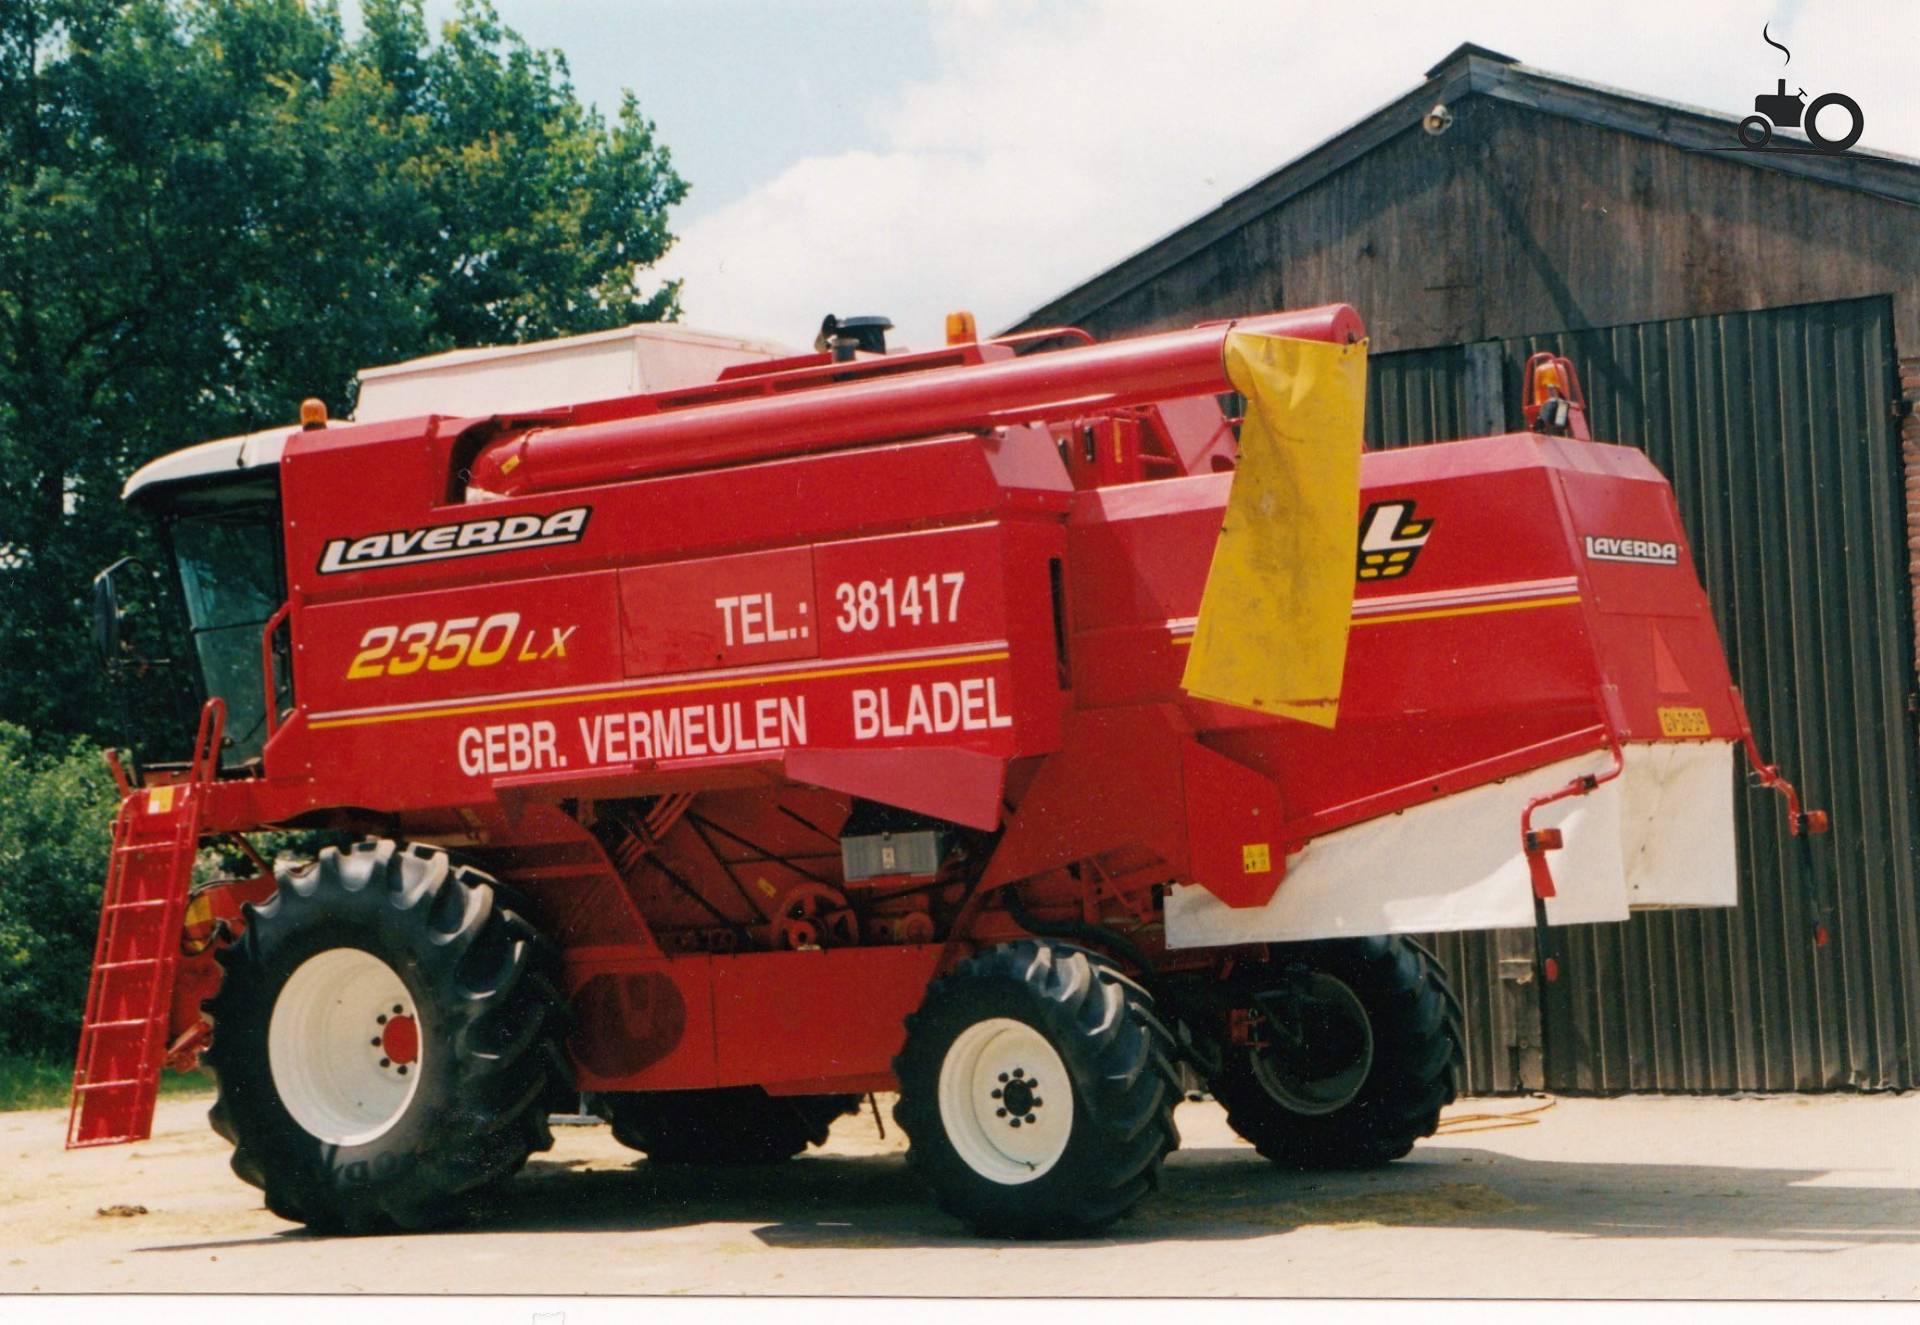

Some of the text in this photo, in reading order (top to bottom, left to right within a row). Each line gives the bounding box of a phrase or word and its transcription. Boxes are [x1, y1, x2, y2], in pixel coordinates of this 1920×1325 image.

[320, 508, 588, 573] LAVERDA
[1585, 536, 1677, 565] LAVERDA
[715, 571, 965, 646] TEL.: 381417
[347, 612, 578, 679] 2350 LX
[458, 677, 1012, 777] GEBR. VERMEULEN BLADEL
